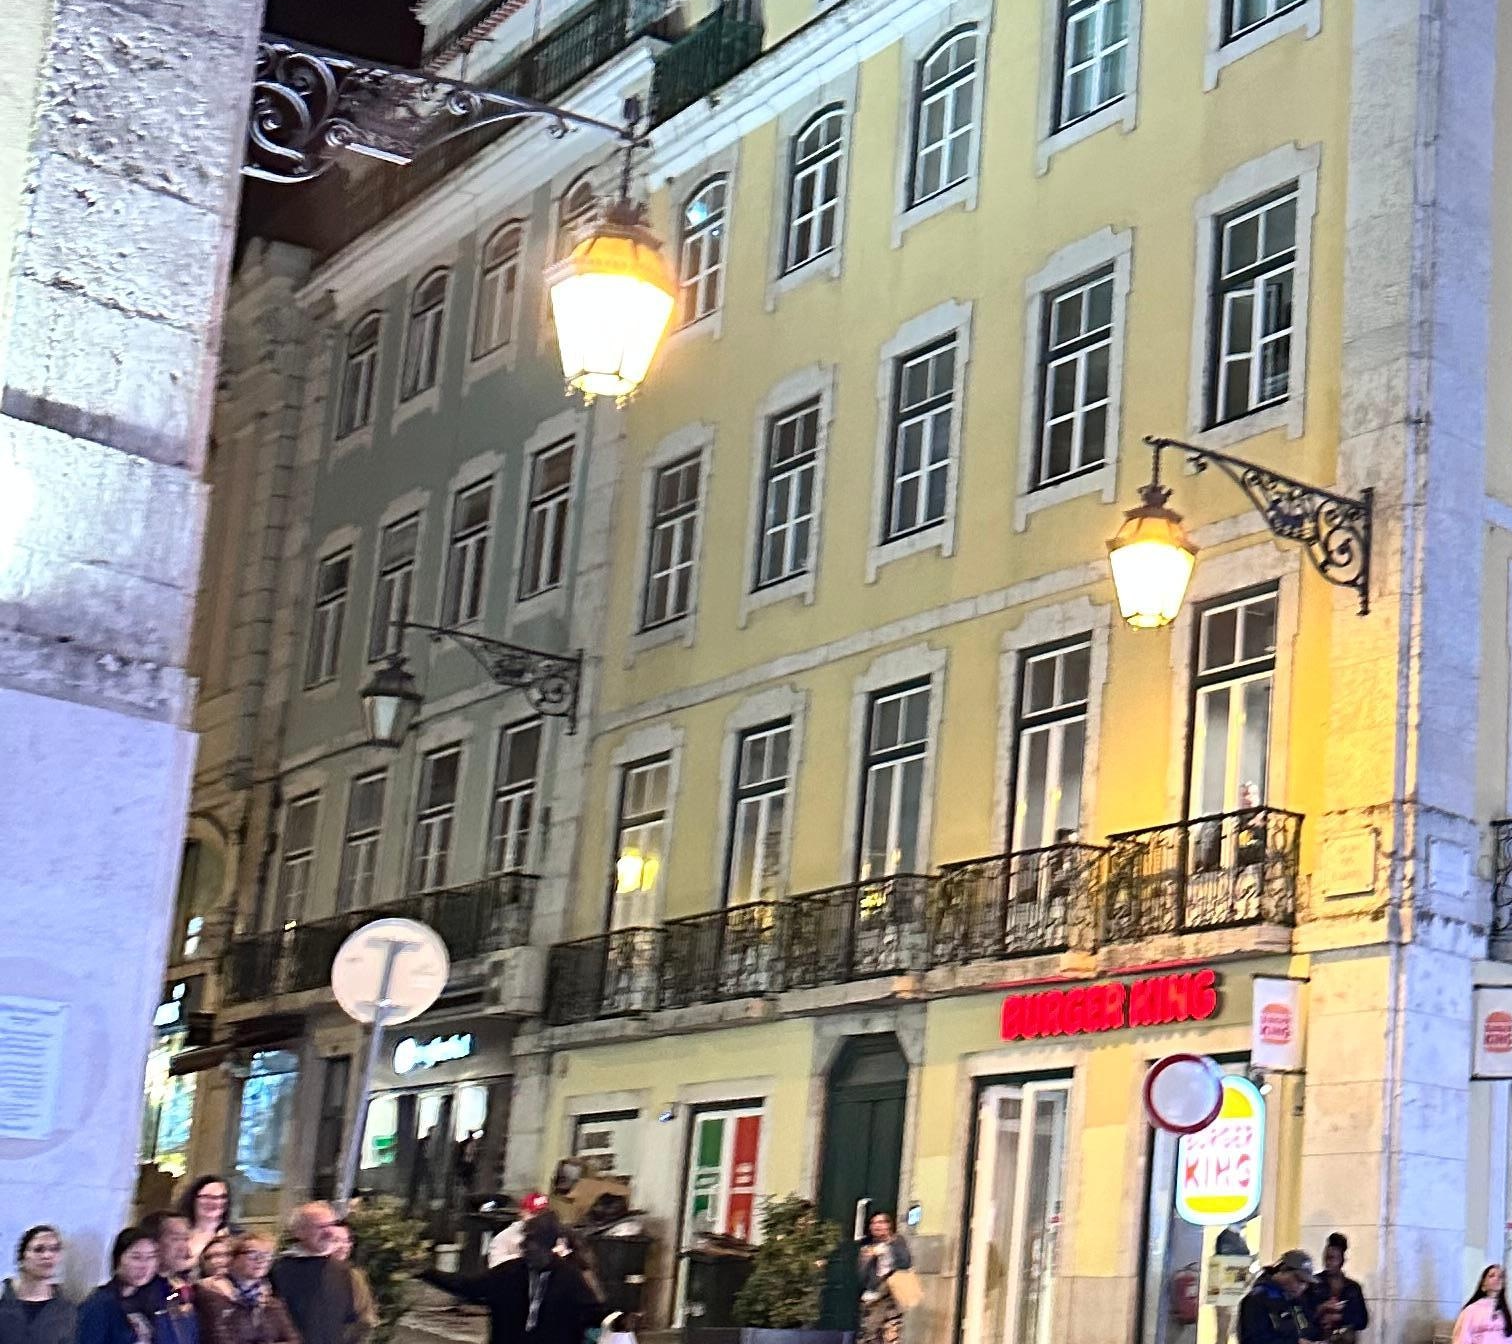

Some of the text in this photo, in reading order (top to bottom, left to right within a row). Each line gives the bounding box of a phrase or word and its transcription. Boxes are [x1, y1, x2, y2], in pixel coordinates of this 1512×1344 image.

[1000, 968, 1217, 1041] BURGER KING
[1183, 1153, 1252, 1190] KING
